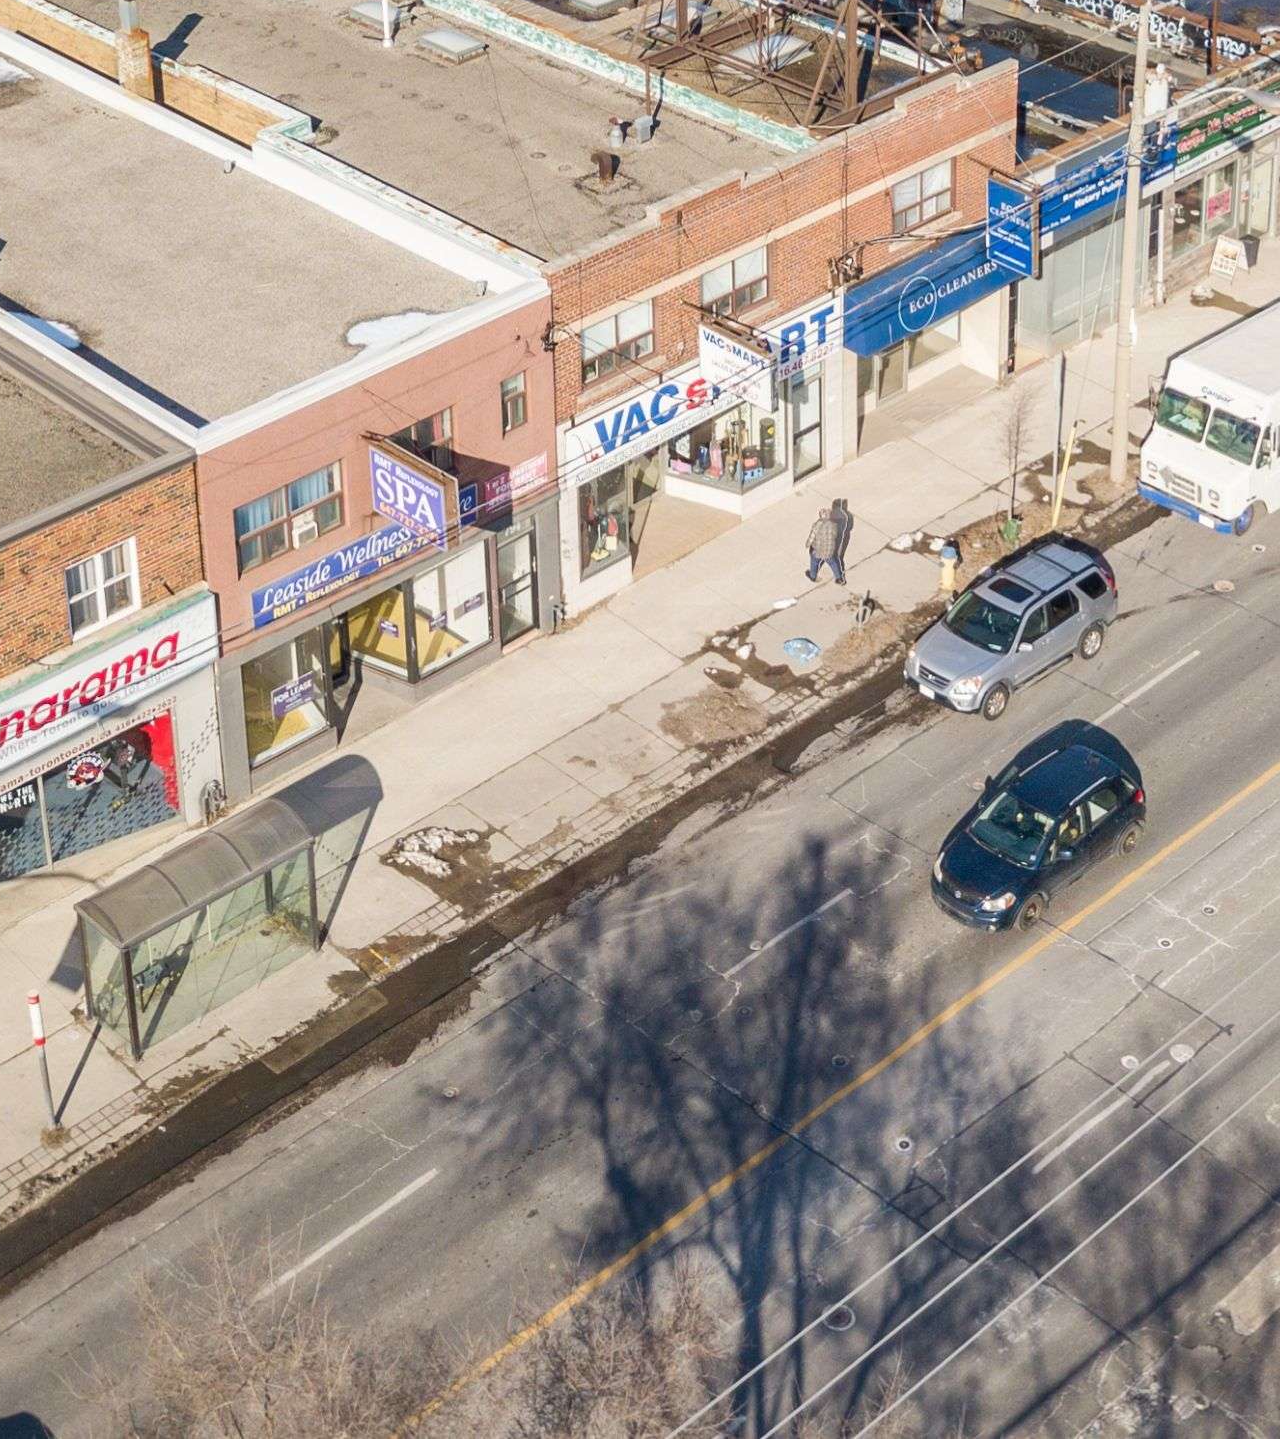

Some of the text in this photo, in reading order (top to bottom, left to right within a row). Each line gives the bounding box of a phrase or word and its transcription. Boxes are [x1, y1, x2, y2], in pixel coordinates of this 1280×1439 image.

[908, 260, 999, 314] ECO CLEANERS
[1201, 385, 1232, 403] Canpar
[373, 451, 393, 471] RMT
[375, 468, 438, 531] SPA
[260, 524, 412, 614] Leaside Wellness
[273, 598, 297, 619] RMT
[273, 678, 312, 705] FOR LEASE
[41, 709, 89, 737] Toronto
[16, 784, 34, 797] THE
[0, 792, 36, 814] NORTH
